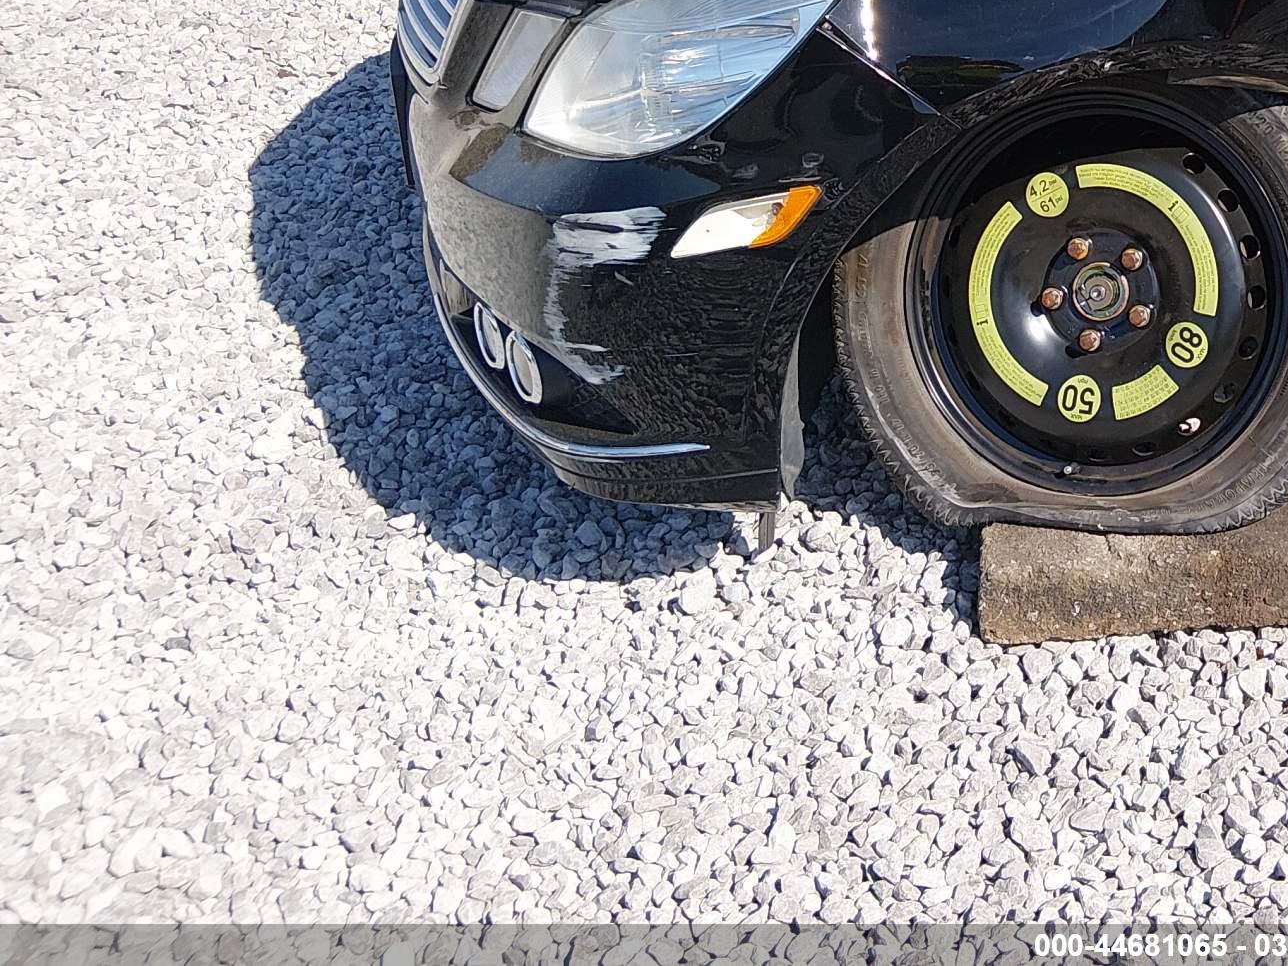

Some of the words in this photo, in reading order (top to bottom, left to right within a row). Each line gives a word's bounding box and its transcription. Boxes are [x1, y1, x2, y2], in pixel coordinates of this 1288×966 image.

[1030, 180, 1049, 196] 4,2
[1040, 196, 1056, 212] 61
[1171, 327, 1203, 363] 80
[1062, 385, 1095, 415] 50
